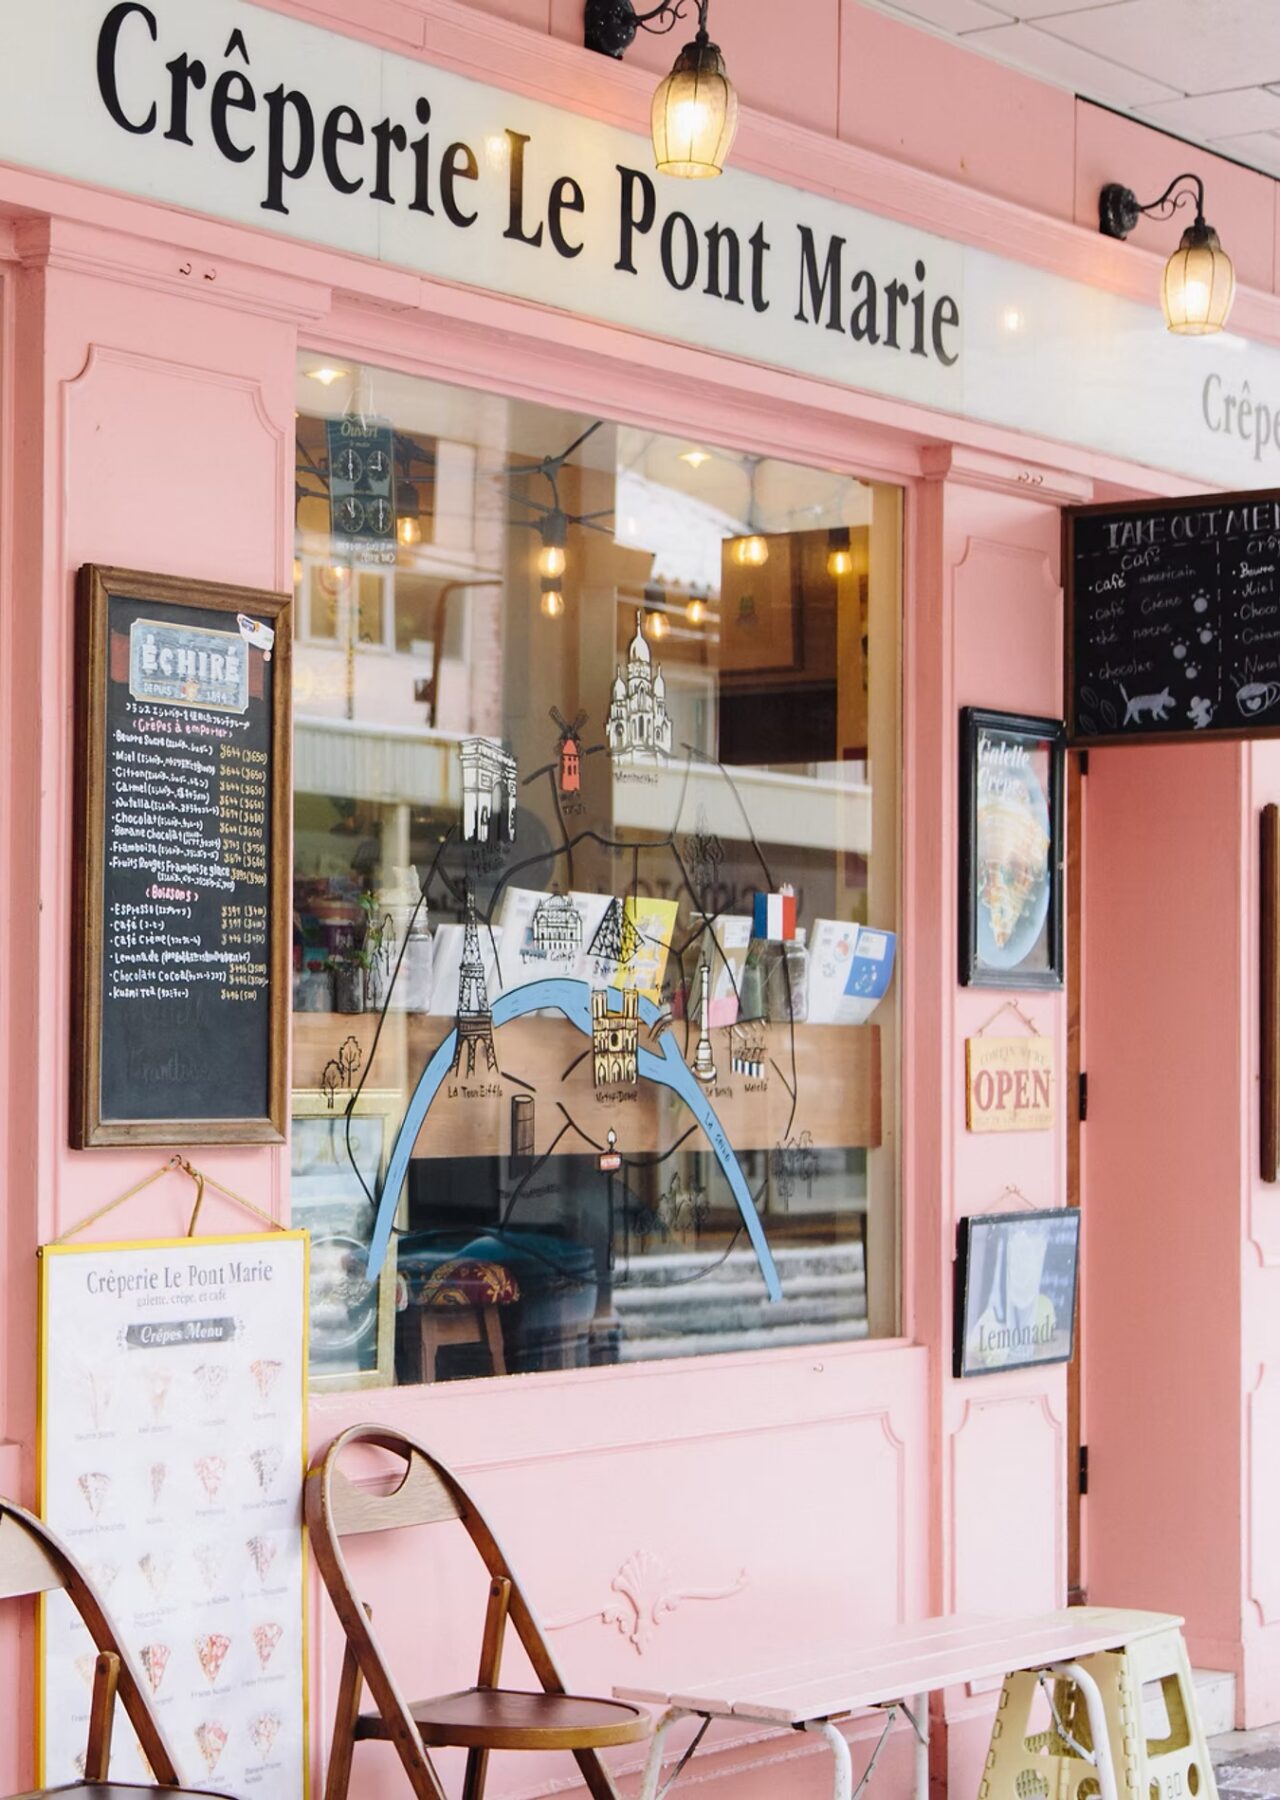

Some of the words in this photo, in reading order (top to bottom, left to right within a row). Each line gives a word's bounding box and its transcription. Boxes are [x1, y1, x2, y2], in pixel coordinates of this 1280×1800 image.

[96, 1, 479, 228] Crêperie
[502, 129, 584, 259] Le
[613, 164, 771, 314] Pont
[795, 223, 960, 367] Marie
[1102, 517, 1166, 549] TAKE
[1171, 508, 1222, 539] OUT
[974, 1069, 1051, 1112] OPEN
[87, 1268, 158, 1298] Crêperie
[164, 1266, 181, 1288] Le
[189, 1264, 225, 1287] Pont
[229, 1260, 273, 1284] Marie
[141, 1325, 182, 1346] Crêpes
[185, 1322, 223, 1340] Menu
[978, 1315, 1057, 1352] Lemonade
